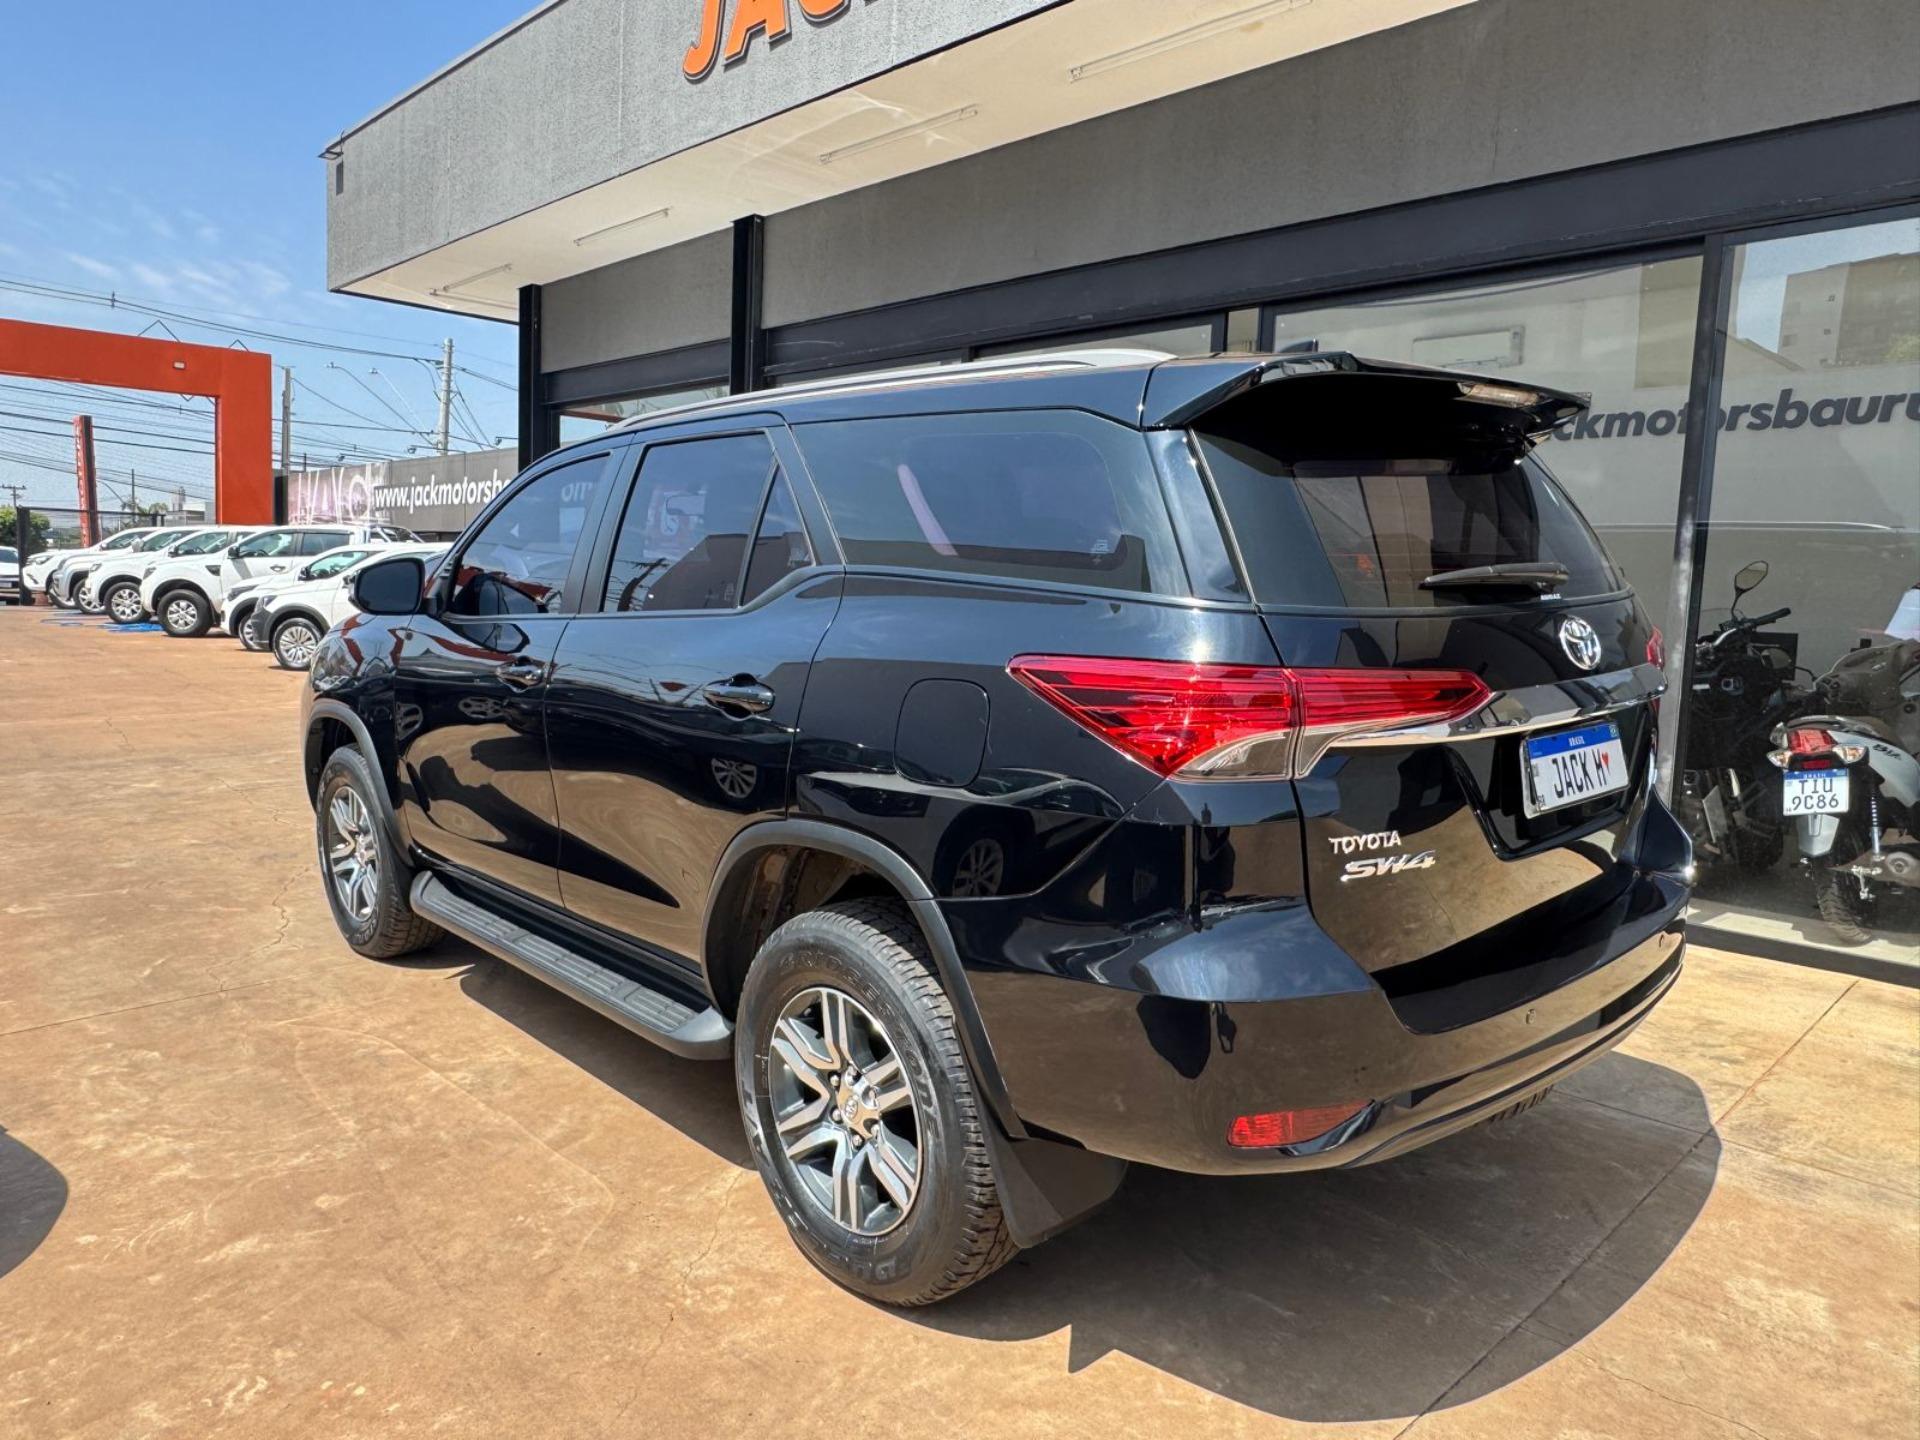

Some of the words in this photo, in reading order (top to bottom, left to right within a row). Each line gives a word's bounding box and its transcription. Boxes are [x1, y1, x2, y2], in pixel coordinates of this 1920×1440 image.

[1552, 749, 1595, 799] JACK
[1798, 778, 1833, 795] TIU
[1792, 793, 1840, 811] 9C86
[1328, 830, 1402, 854] TOYOTA
